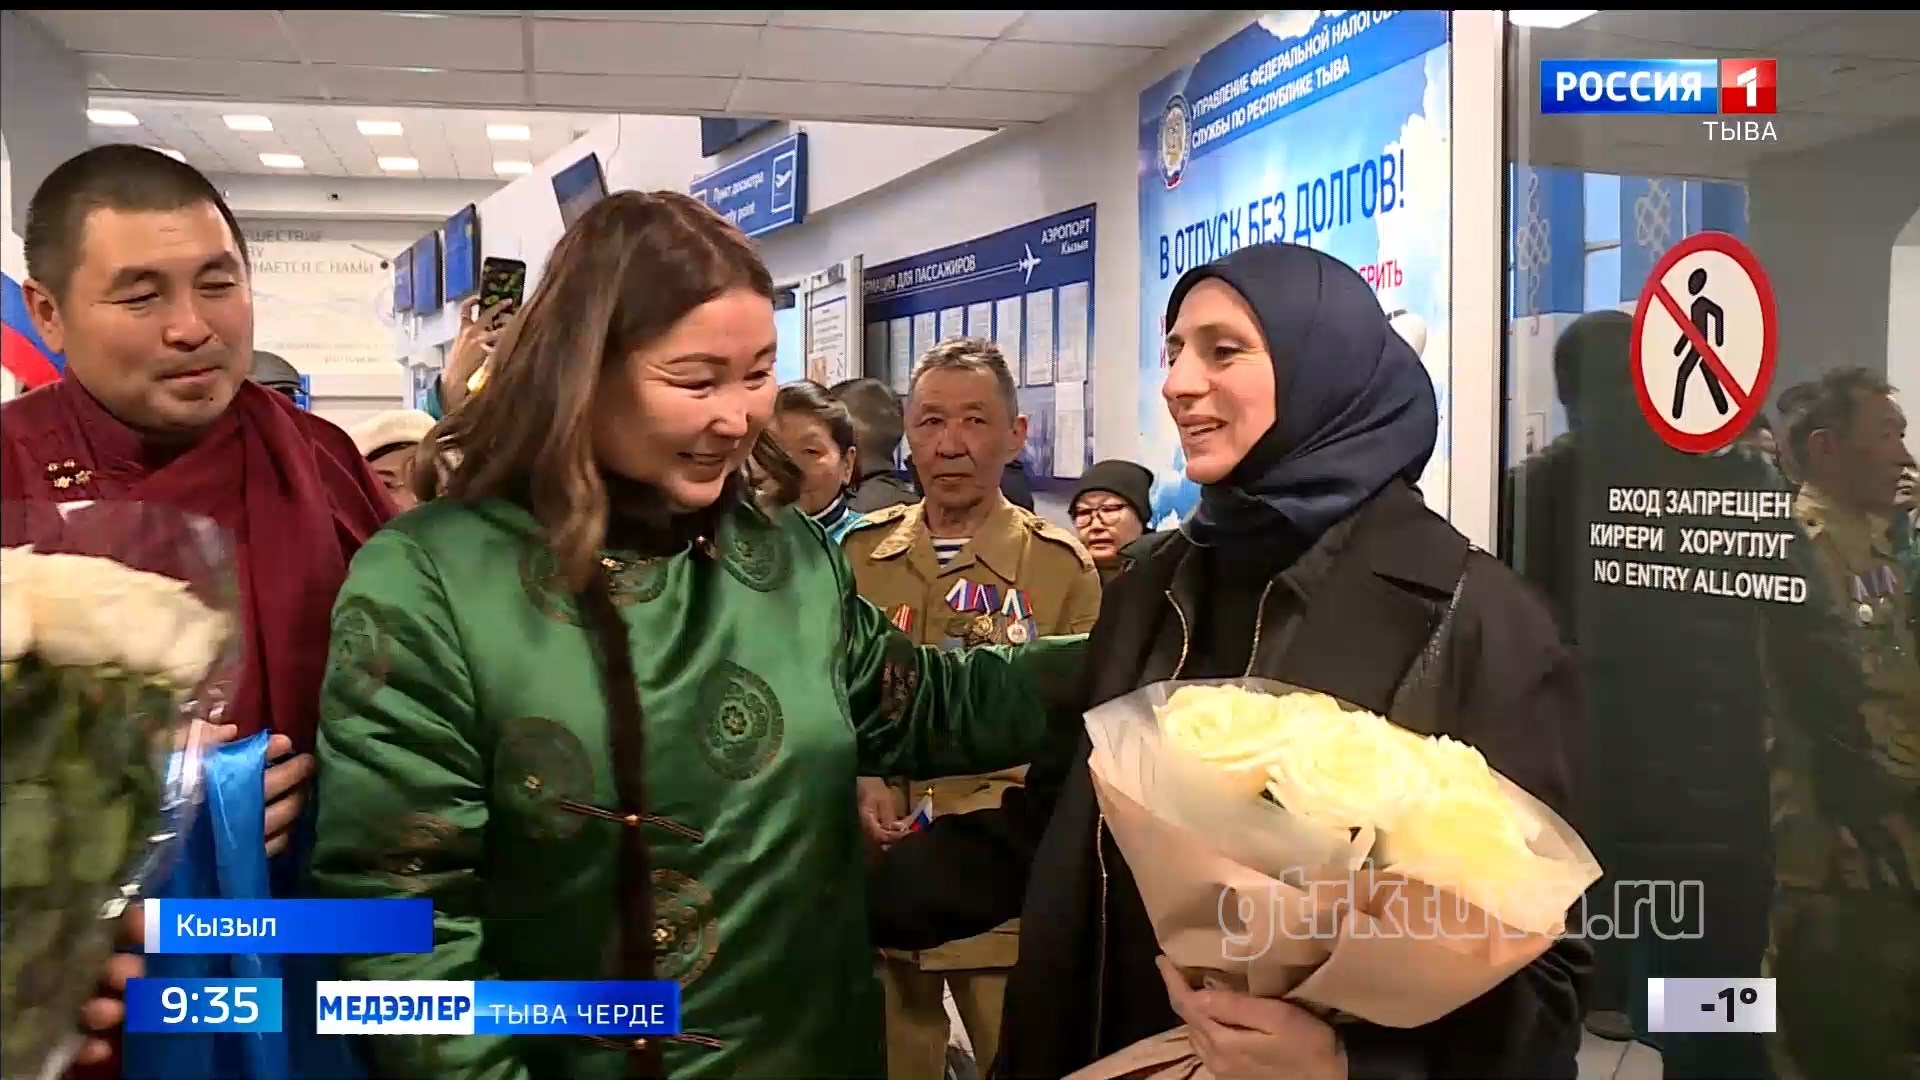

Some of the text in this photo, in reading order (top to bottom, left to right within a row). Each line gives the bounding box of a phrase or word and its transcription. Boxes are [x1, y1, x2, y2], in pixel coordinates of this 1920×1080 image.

[1192, 10, 1400, 119] УПРАВЛЕНИЕ ФЕДЕРАЛЬНОЙ НАЛОГО
[1192, 54, 1351, 149] СЛУЖБЫ ПО РЕСПУБЛИКЕ ТЫВА
[1041, 218, 1090, 245] АЭРОПОРТ
[1159, 148, 1405, 280] В ОТПУСК БЕЗ ДОЛГОВ!
[254, 260, 310, 273] НАЕТСЯ
[897, 269, 914, 289] ДЛЯ
[914, 254, 976, 285] ПАССАЖИРОВ
[1609, 488, 1791, 522] ВХОД ЗАПРЕЩЕН
[1590, 523, 1795, 559] КИРЕРИ ХОРУГЛУГ
[1594, 560, 1807, 603] NO ENTRY ALLOWED
